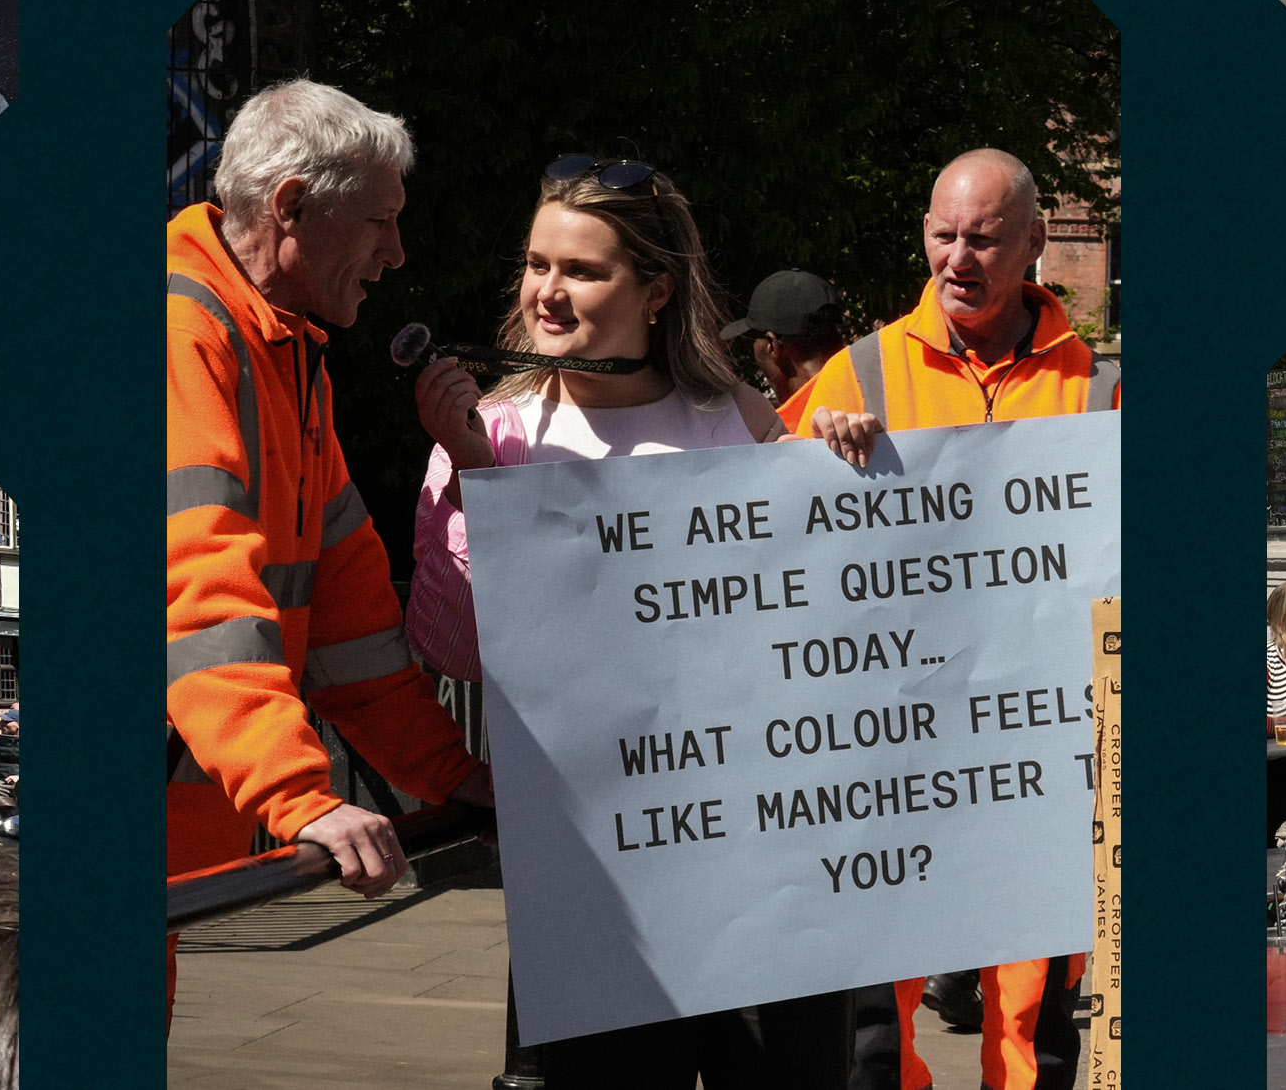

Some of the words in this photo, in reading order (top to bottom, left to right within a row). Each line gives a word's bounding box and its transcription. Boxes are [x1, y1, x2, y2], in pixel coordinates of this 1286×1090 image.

[505, 352, 549, 366] JAMES
[554, 359, 614, 372] CROPPER
[595, 511, 654, 553] WE
[686, 500, 773, 545] ARE
[805, 482, 974, 535] ASKING
[1004, 472, 1092, 515] ONE
[633, 568, 809, 623] SIMPLE
[840, 543, 1068, 602] QUESTION
[619, 725, 732, 777] WHAT
[765, 702, 937, 758] COLOUR
[1111, 724, 1121, 818] CROPPER
[614, 799, 726, 851] LIKE
[756, 759, 1044, 832] MANCHESTER
[820, 844, 933, 893] YOU?
[1096, 874, 1106, 939] JAMES
[1110, 894, 1121, 989] CROPPER
